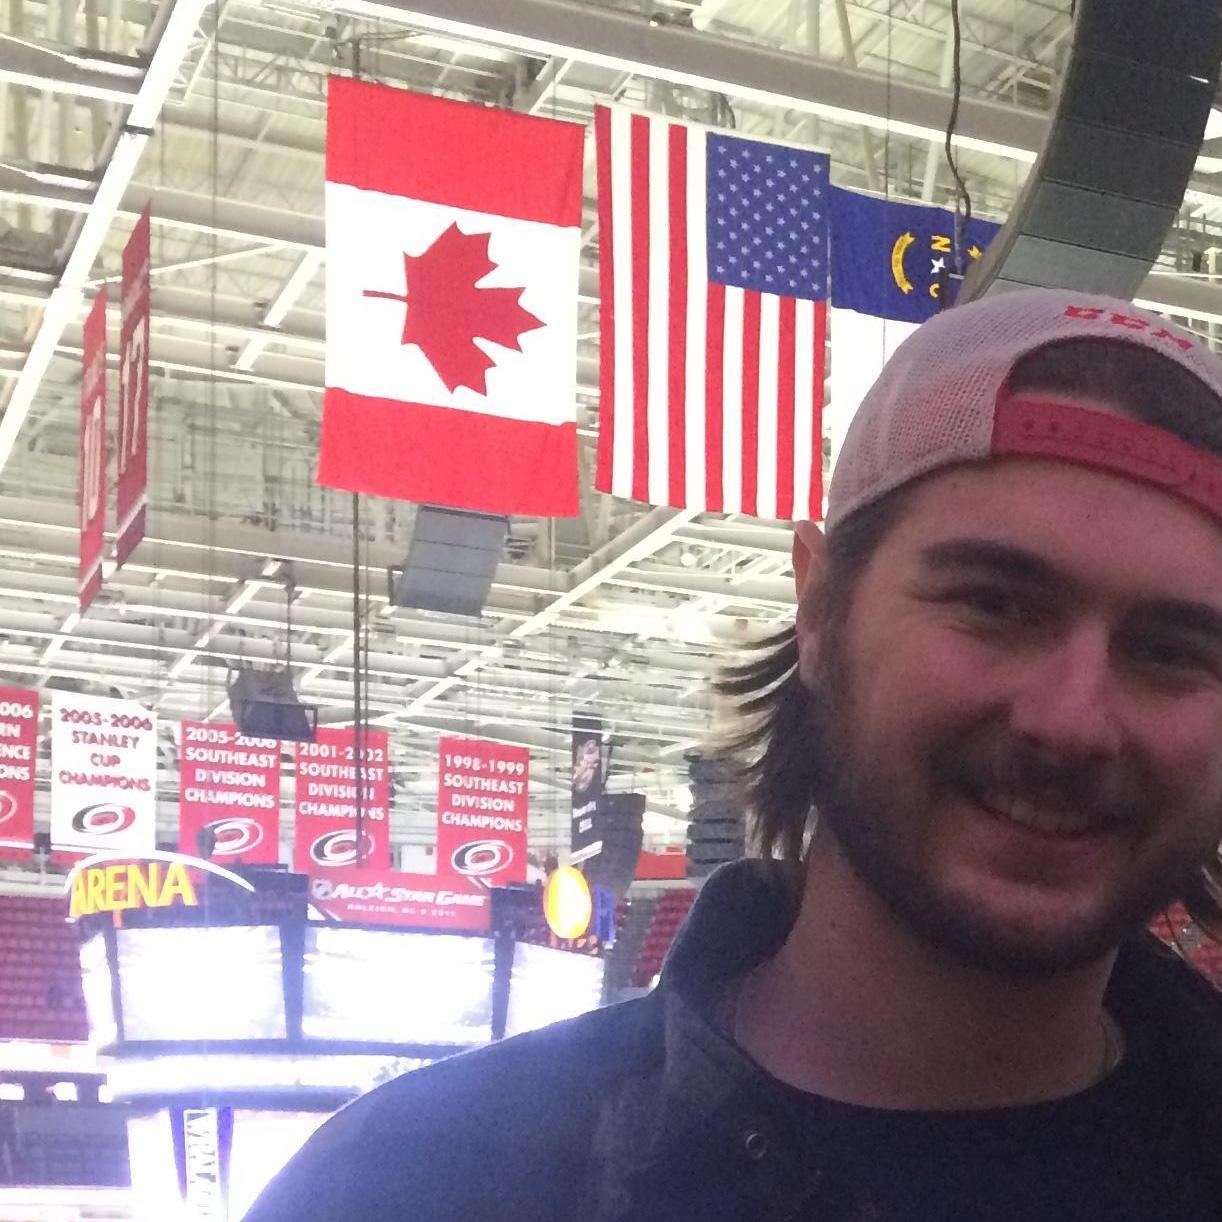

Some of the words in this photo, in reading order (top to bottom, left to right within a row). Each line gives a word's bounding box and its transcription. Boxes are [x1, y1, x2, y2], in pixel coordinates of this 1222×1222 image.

[59, 707, 153, 731] 2005-2006
[72, 730, 140, 749] STANLEY
[90, 752, 121, 767] CUP
[185, 747, 277, 768] SOUTHEAST
[299, 742, 385, 762] 2001-202
[445, 754, 525, 776] 1998-1999
[58, 770, 151, 792] CHAMPIONS
[194, 769, 266, 787] DIVISION
[443, 772, 524, 794] SOUTHEAST
[184, 788, 275, 809] CHAMPIONS
[451, 793, 515, 813] DIVISION
[441, 811, 523, 832] CHAMPIONS
[69, 860, 199, 919] ARENA
[434, 890, 487, 907] GAME
